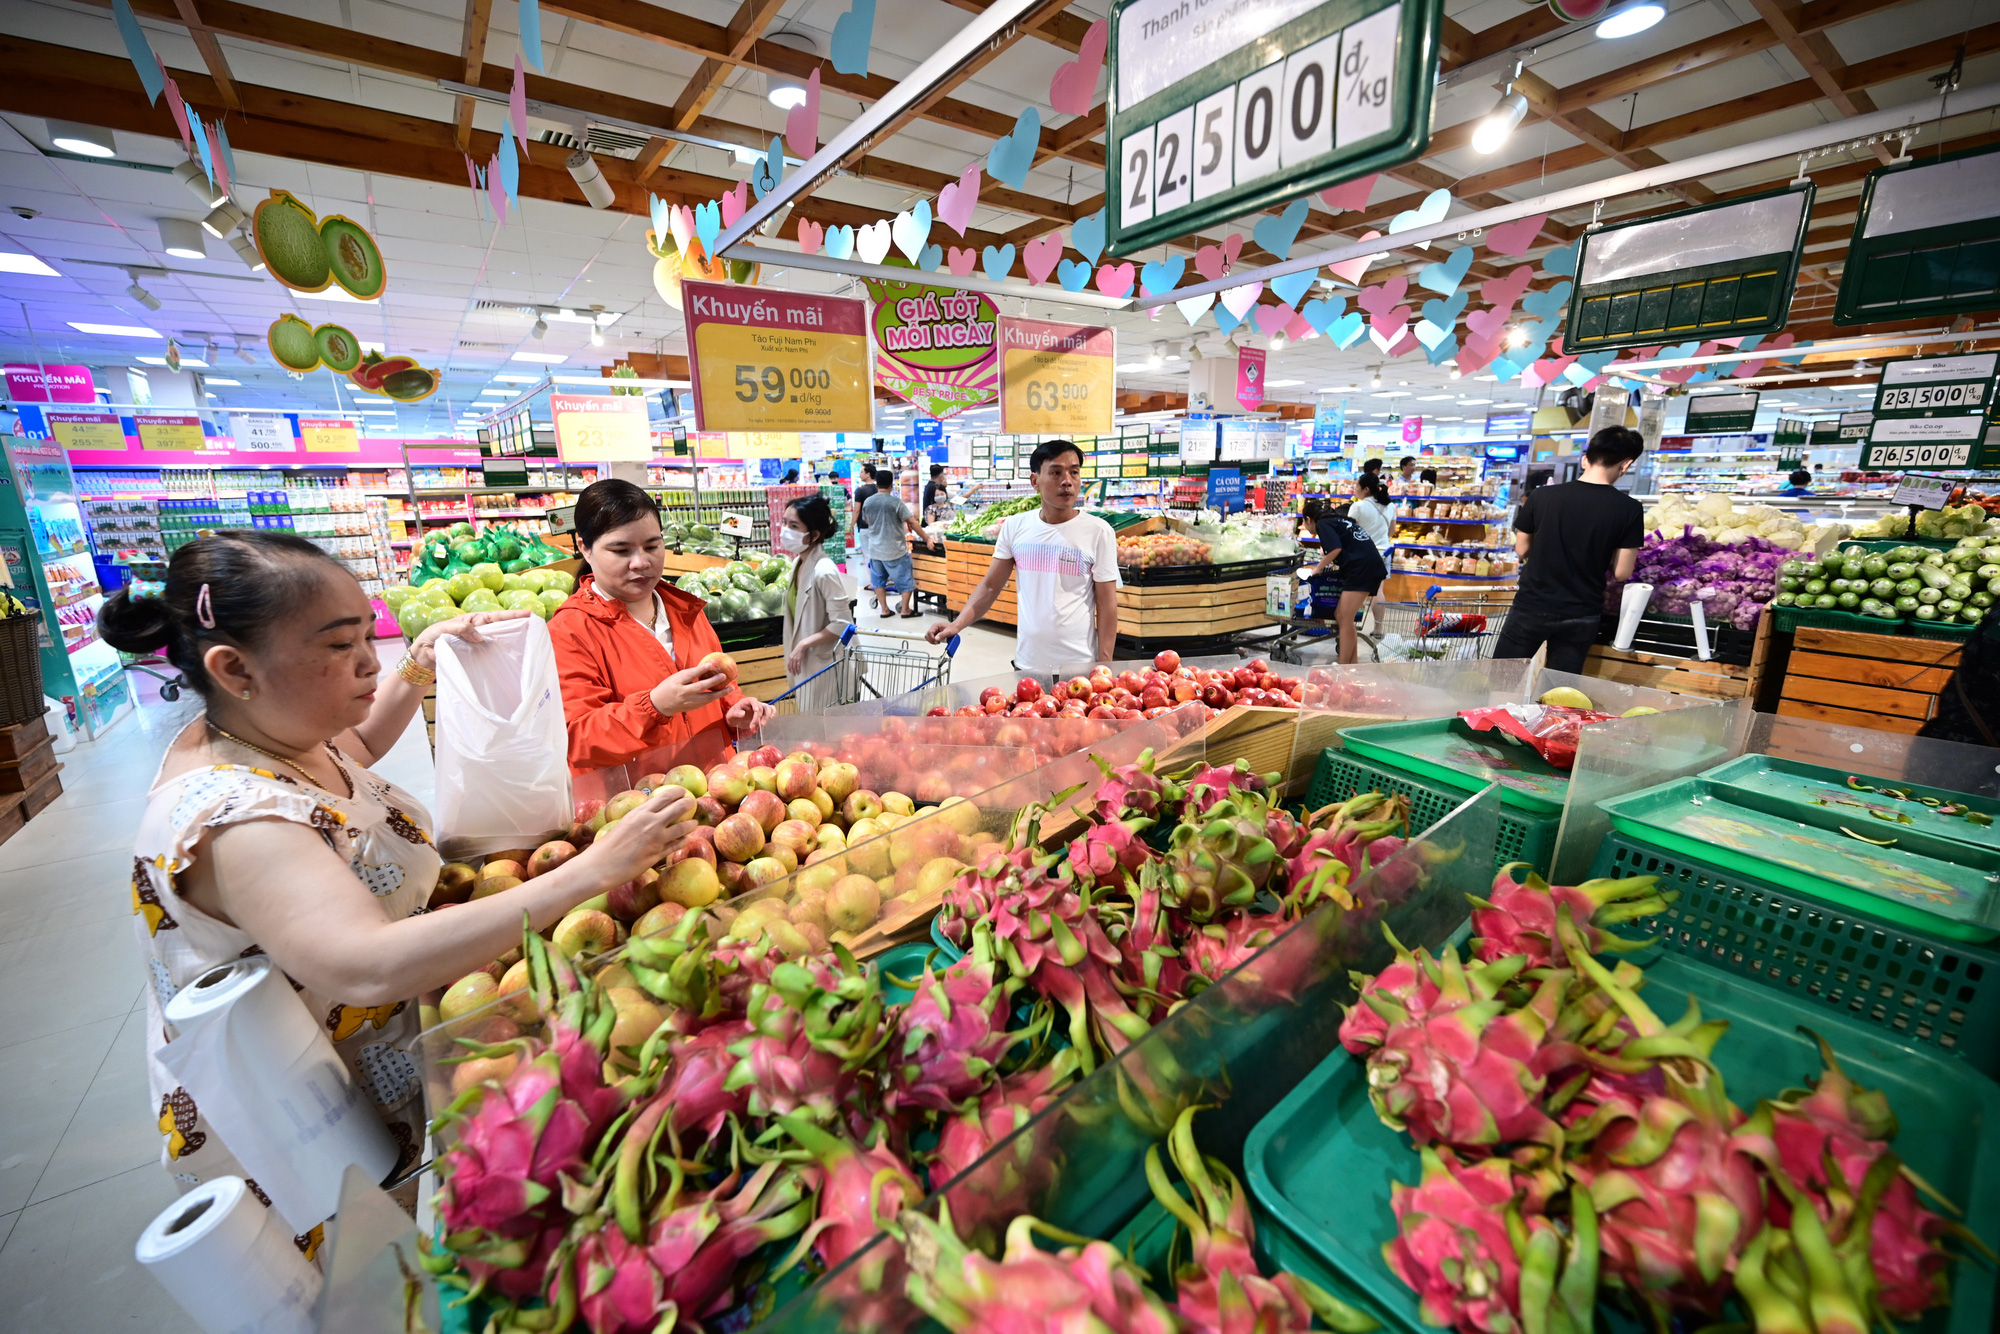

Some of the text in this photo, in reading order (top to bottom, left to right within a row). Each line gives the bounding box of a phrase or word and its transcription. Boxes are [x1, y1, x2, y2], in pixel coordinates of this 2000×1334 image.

[1141, 2, 1190, 41] Thanh
[1128, 62, 1324, 209] 22.500
[692, 295, 823, 326] Khuyến mãi
[898, 289, 979, 320] GIÁ TỐT
[751, 334, 768, 344] Táo
[769, 336, 783, 346] Fuji
[784, 337, 802, 346] Nam
[886, 320, 994, 350] MỖI NGÀY
[1004, 327, 1087, 350] Khuyến mãi
[12, 373, 86, 385] KHUYẾN MÃI
[799, 392, 822, 405] đ/kg
[913, 386, 967, 401] BEST PRICE
[1884, 388, 1962, 405] 23.500
[554, 400, 623, 413] Khuyến mãi
[49, 415, 83, 423] Khuyến
[136, 417, 168, 425] Khuyến
[1872, 447, 1950, 462] 26.500
[1215, 477, 1240, 486] CÁ CƠM
